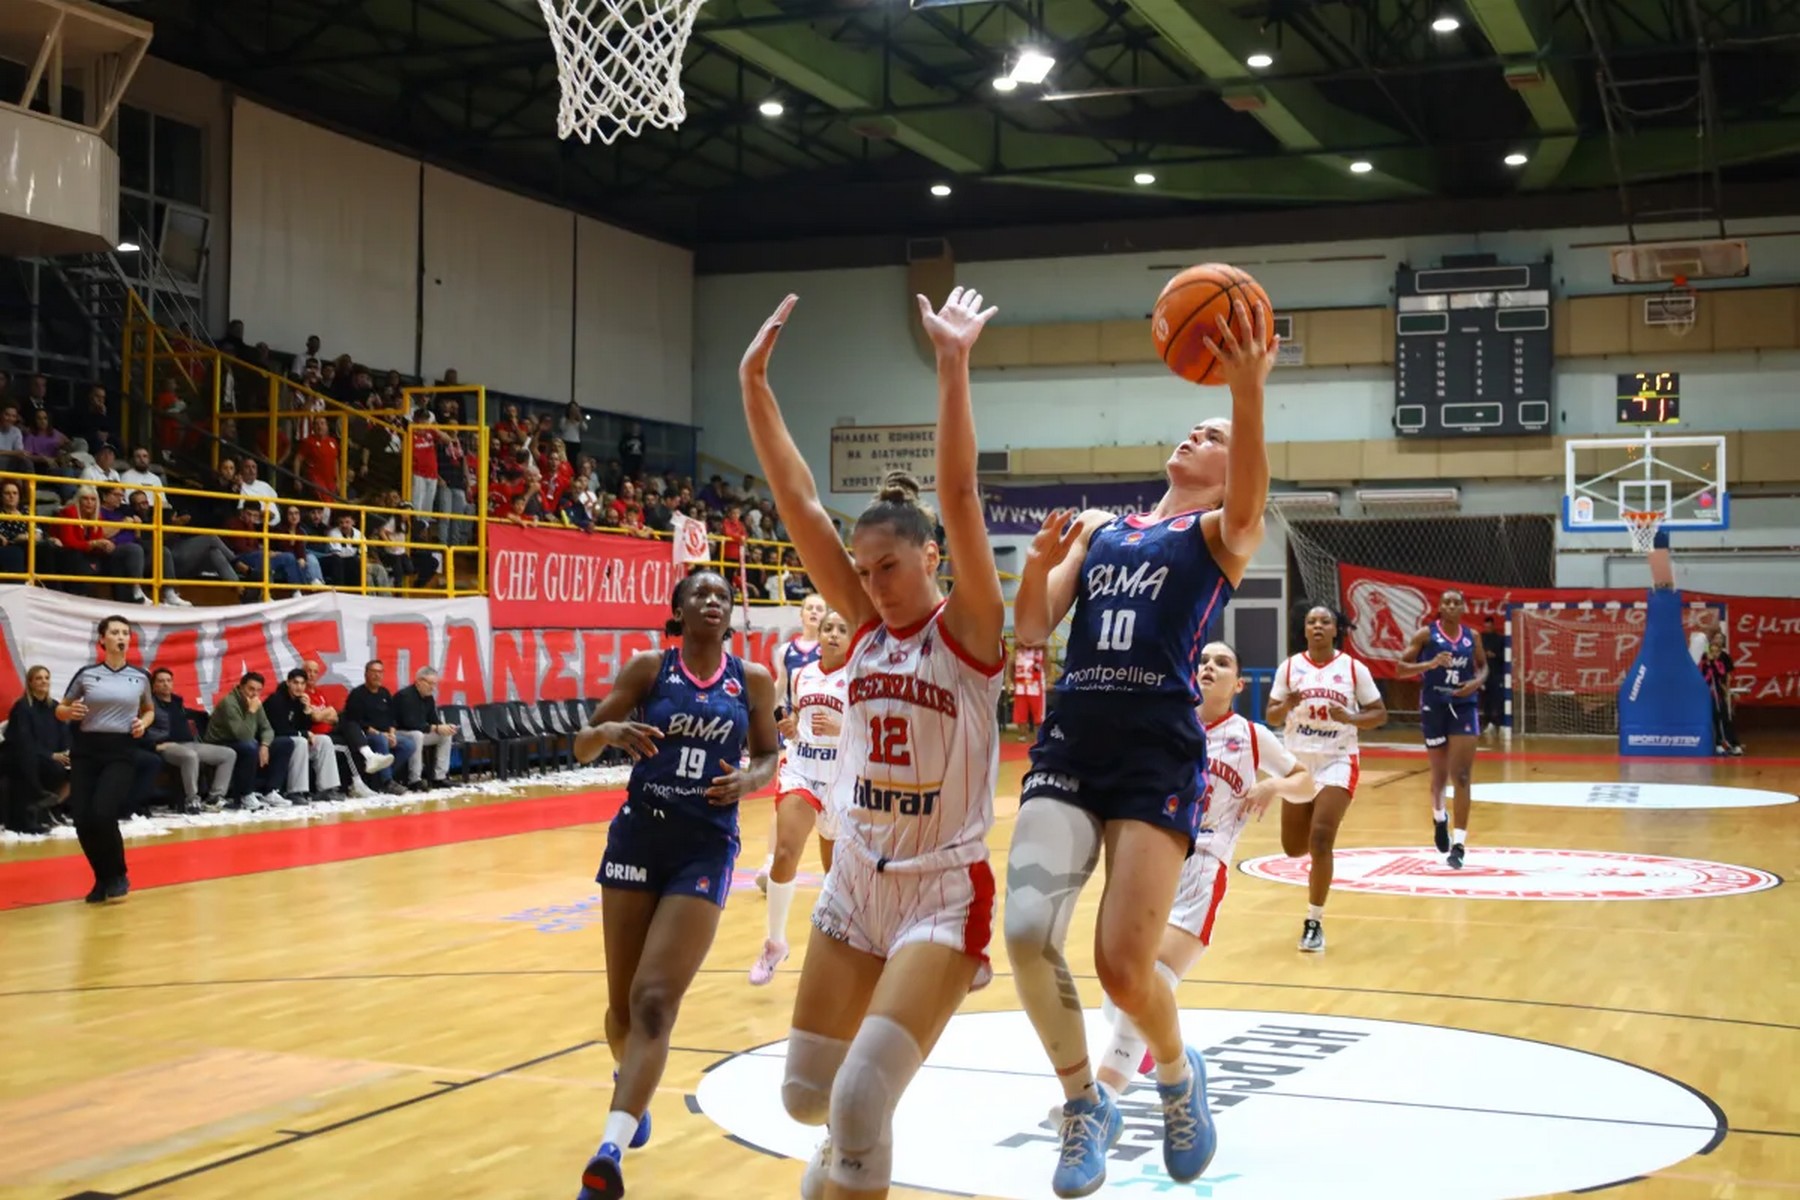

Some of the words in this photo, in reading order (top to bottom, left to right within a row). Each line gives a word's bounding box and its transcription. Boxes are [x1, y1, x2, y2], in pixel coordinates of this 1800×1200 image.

[493, 549, 538, 601] CHE
[542, 551, 636, 604] GUEVARA
[1087, 560, 1170, 601] BLMA
[1097, 609, 1136, 651] 10
[665, 712, 735, 744] BLMA
[1308, 705, 1328, 721] 14
[869, 715, 911, 767] 12
[675, 746, 707, 780] 19
[605, 861, 648, 883] GRIM
